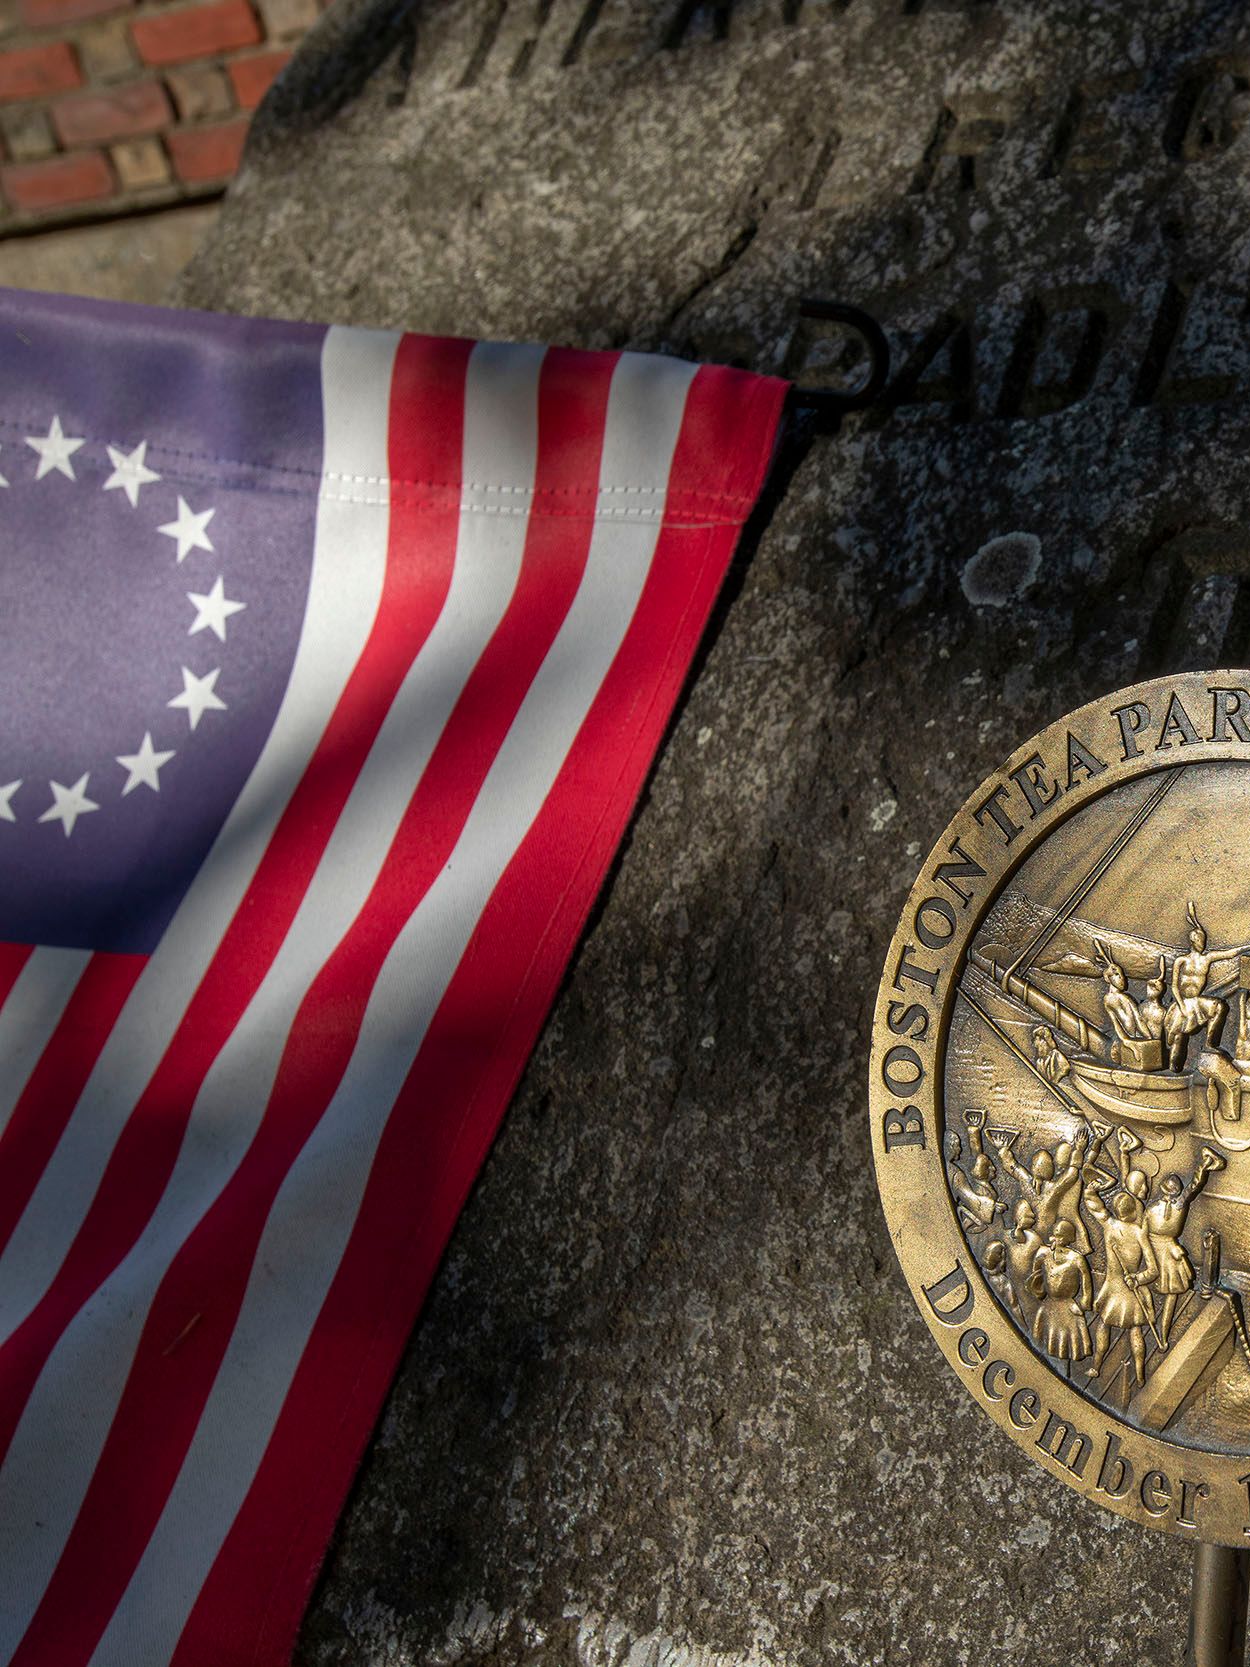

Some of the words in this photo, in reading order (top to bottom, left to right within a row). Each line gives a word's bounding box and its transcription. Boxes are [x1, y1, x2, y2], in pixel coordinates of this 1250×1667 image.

[884, 842, 992, 1152] BOSTON
[973, 728, 1108, 837] TEA
[920, 1258, 1210, 1528] December
